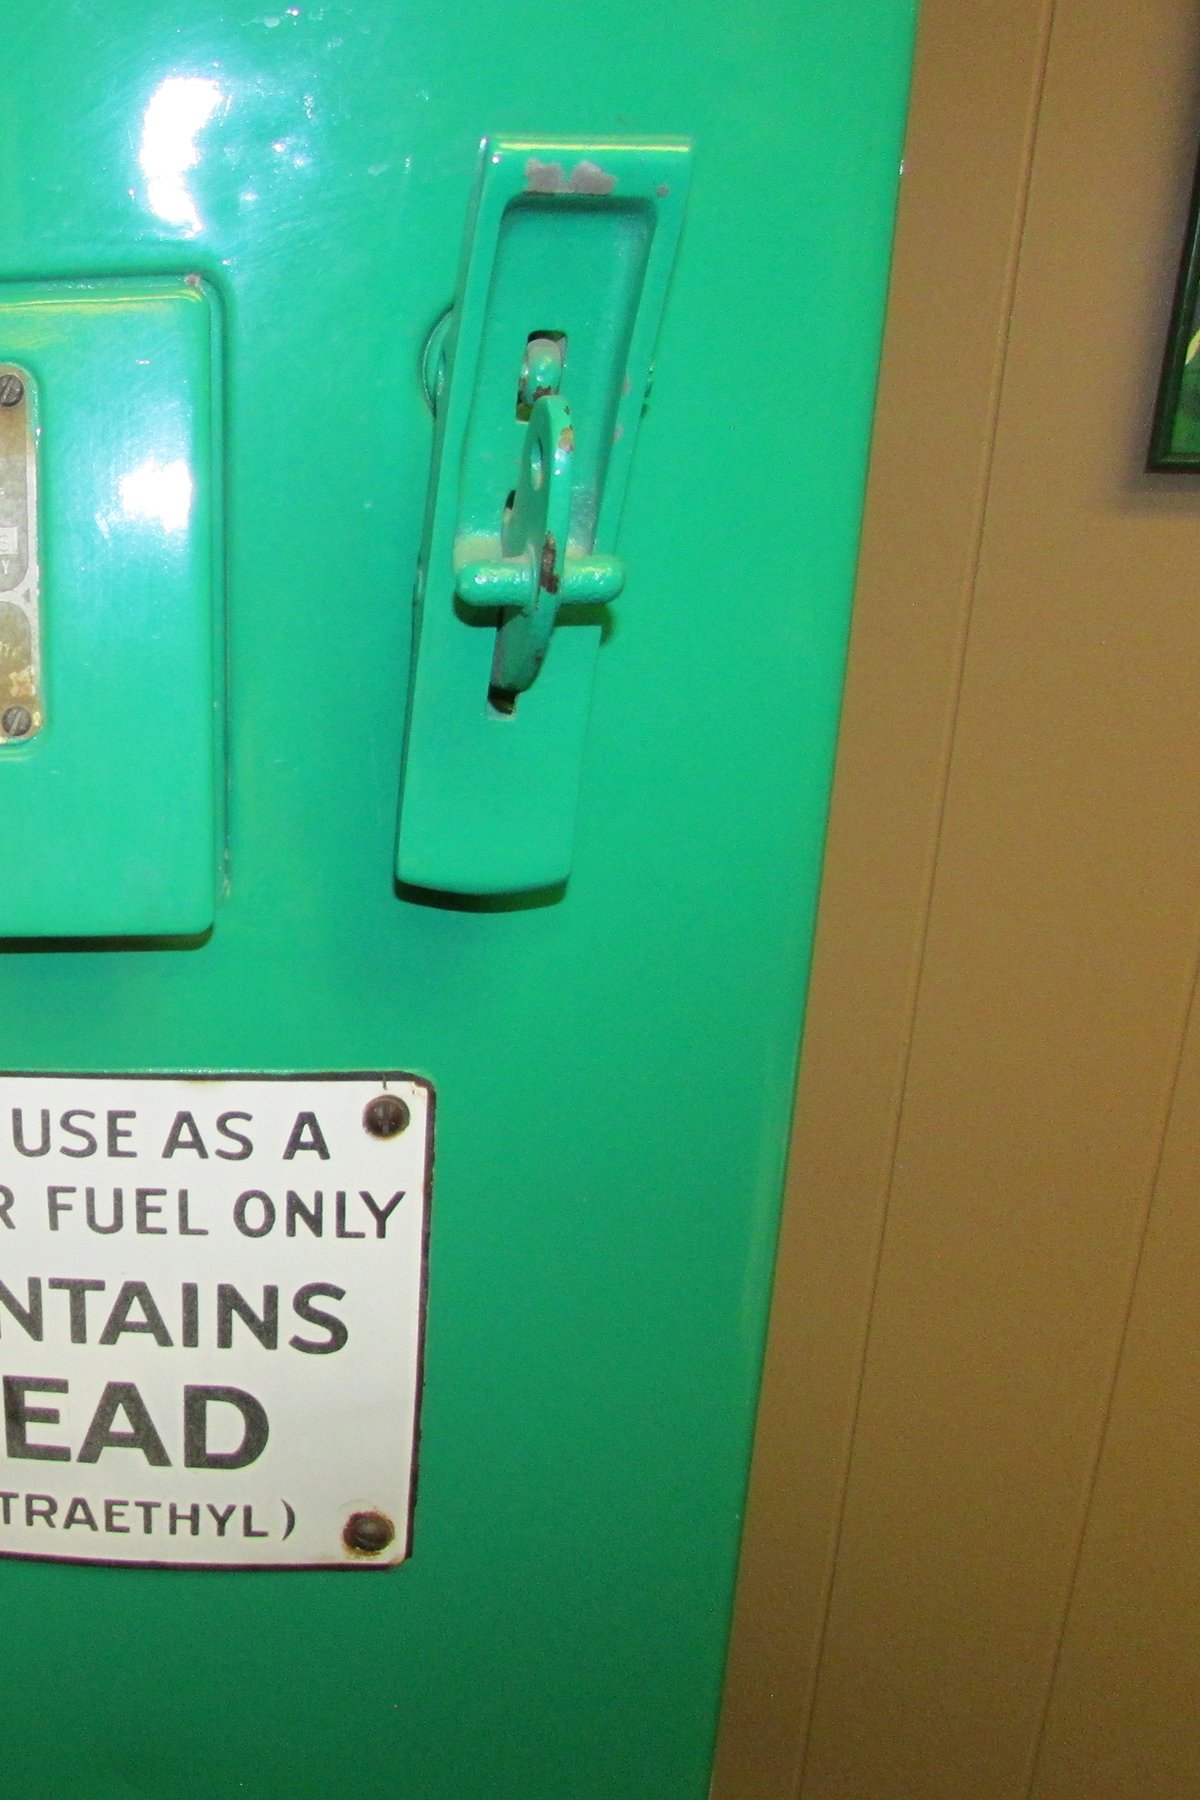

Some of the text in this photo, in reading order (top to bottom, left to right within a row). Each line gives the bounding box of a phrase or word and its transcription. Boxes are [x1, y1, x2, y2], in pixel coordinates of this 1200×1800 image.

[13, 1109, 136, 1157] USE
[163, 1112, 253, 1160] AS
[283, 1112, 330, 1160] A
[48, 1187, 208, 1235] FUEL
[234, 1191, 405, 1238] ONLY
